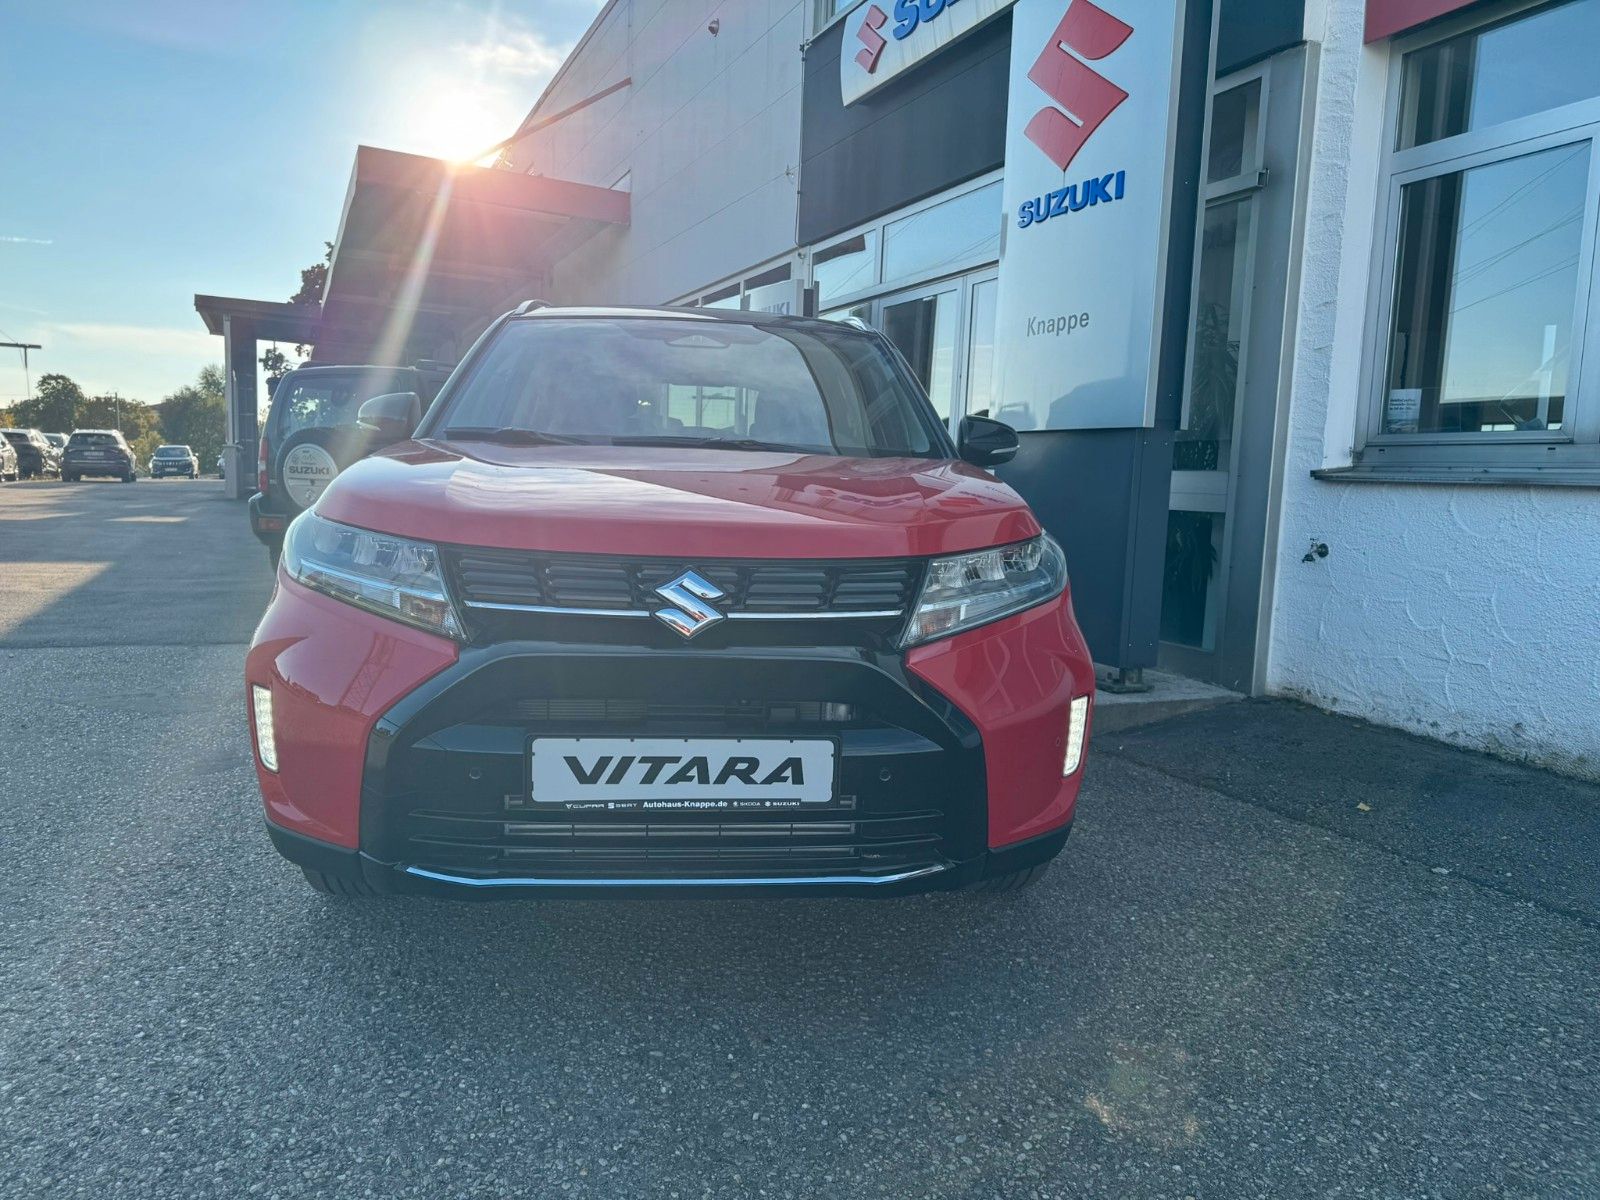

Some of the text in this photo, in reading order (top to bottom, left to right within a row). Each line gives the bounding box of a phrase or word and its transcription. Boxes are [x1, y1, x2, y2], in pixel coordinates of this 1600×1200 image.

[893, 0, 960, 40] SU
[1017, 170, 1126, 229] SUZUKI
[1026, 311, 1090, 337] Knappe
[288, 465, 330, 475] SUZUKI
[562, 755, 805, 785] VITARA
[643, 800, 728, 809] Autohaus-Knappe.de
